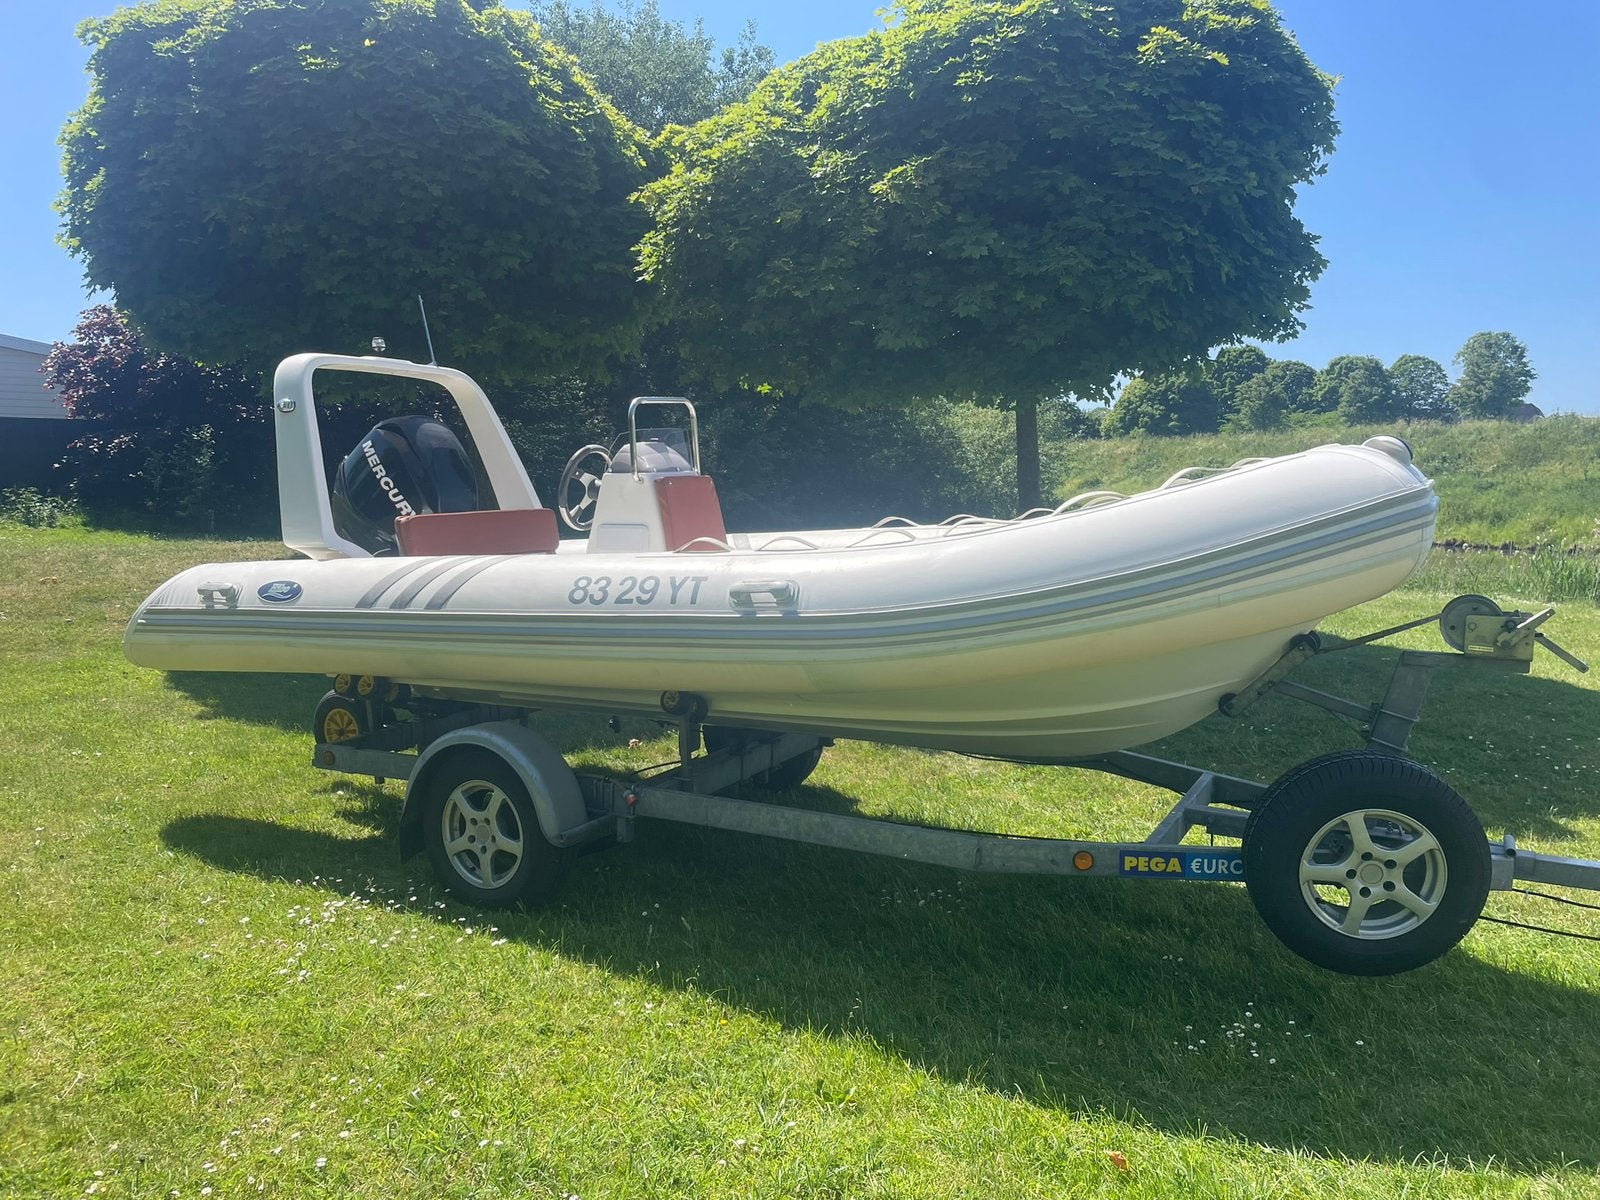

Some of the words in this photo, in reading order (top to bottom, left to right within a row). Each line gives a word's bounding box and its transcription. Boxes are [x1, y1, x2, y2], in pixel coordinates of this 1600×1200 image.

[568, 576, 611, 605] 83
[614, 576, 660, 605] 29
[669, 576, 708, 605] YT
[1124, 856, 1182, 873] PEGA
